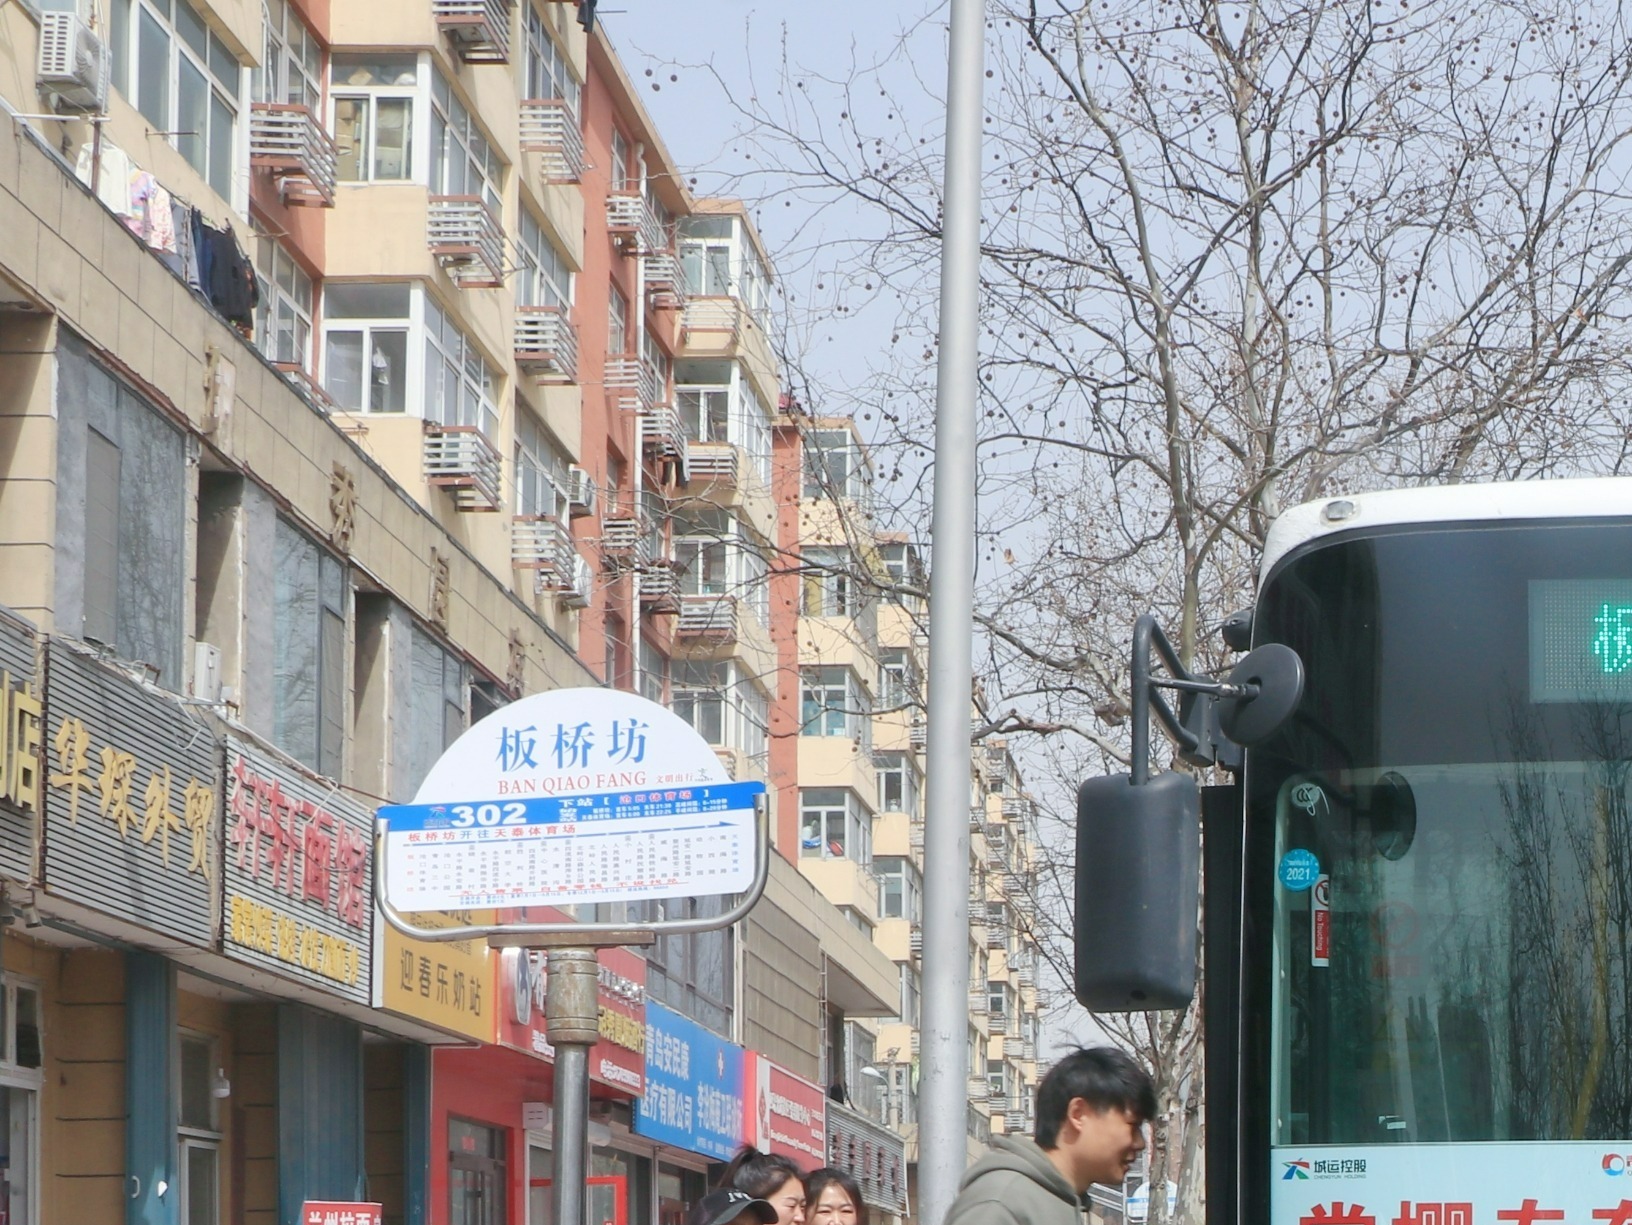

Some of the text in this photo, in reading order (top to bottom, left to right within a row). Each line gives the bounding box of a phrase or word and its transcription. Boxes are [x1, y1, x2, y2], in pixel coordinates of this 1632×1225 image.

[0, 670, 41, 812] 店
[495, 717, 650, 773] 板桥坊
[498, 771, 647, 796] BAN QIAO FANG
[451, 802, 528, 828] 302
[1286, 867, 1311, 881] 2021
[401, 947, 482, 1017] 迎春乐奶站
[645, 1024, 690, 1080] 青岛安民康
[640, 1077, 692, 1134] 医疗有限公司
[1314, 1158, 1367, 1174] 城运控股
